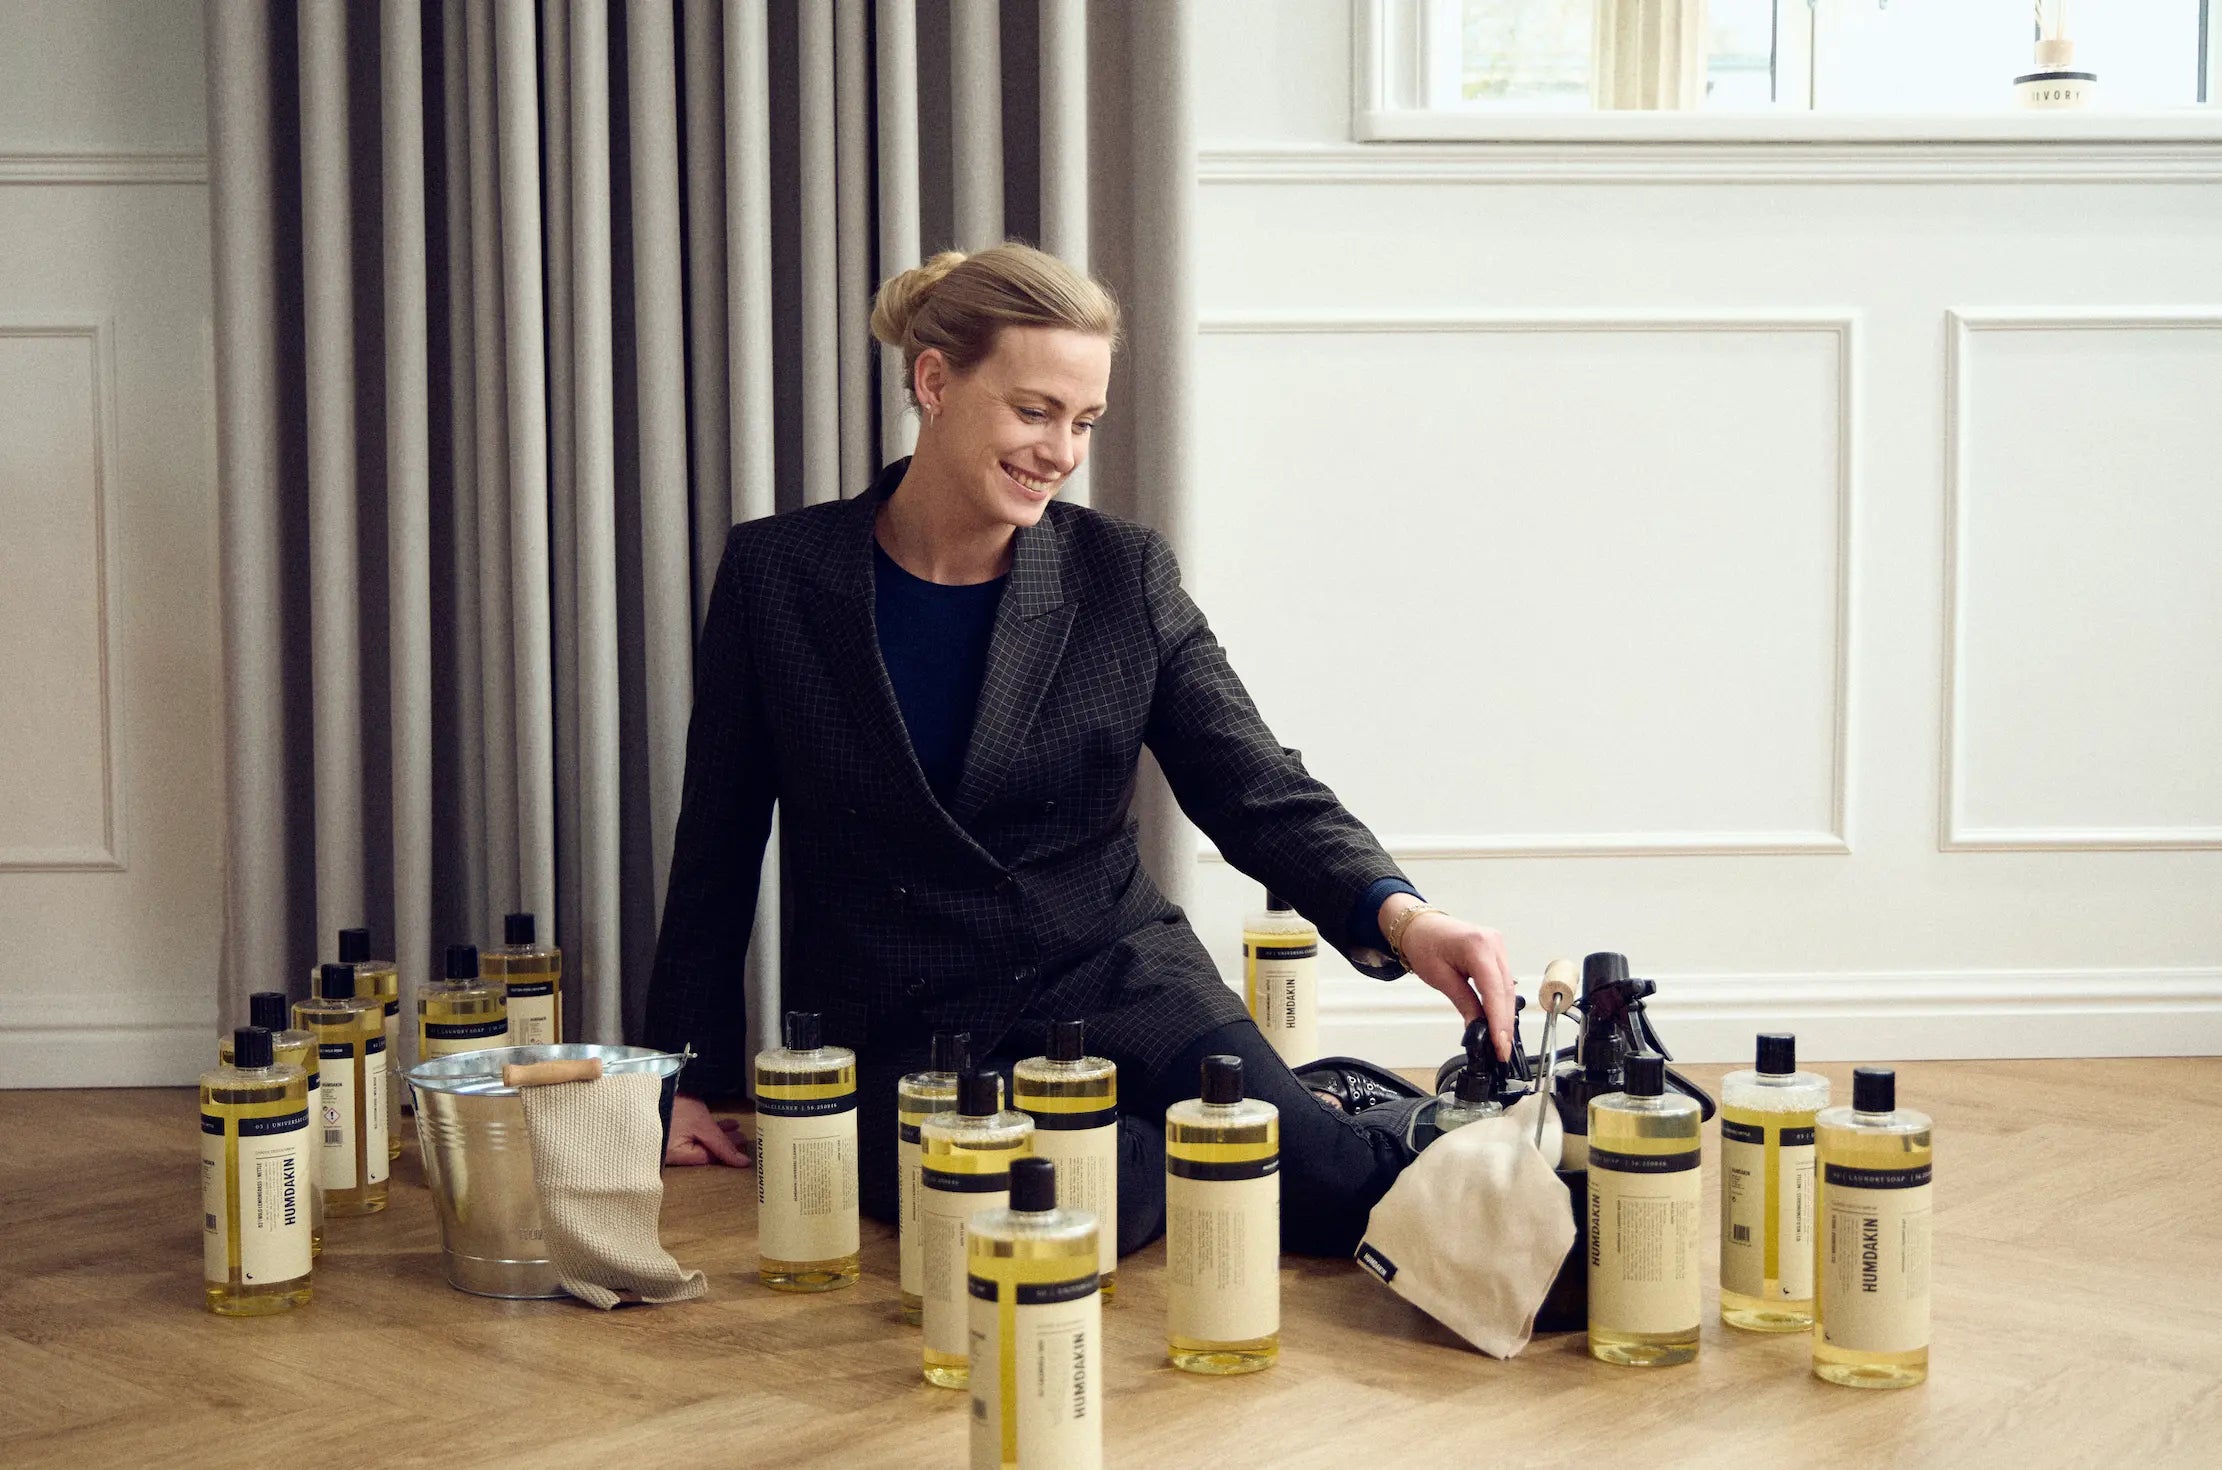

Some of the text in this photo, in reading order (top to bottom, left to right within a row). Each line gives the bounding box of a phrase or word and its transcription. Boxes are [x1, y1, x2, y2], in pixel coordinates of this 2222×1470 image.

[1286, 978, 1296, 1029] HUMDAKIN
[283, 1157, 296, 1226] HUMDAKIN
[1591, 1194, 1600, 1267] HUMDAKIN
[1862, 1218, 1878, 1293] HUMDAKIN
[1073, 1332, 1086, 1419] HUMDAKIN
